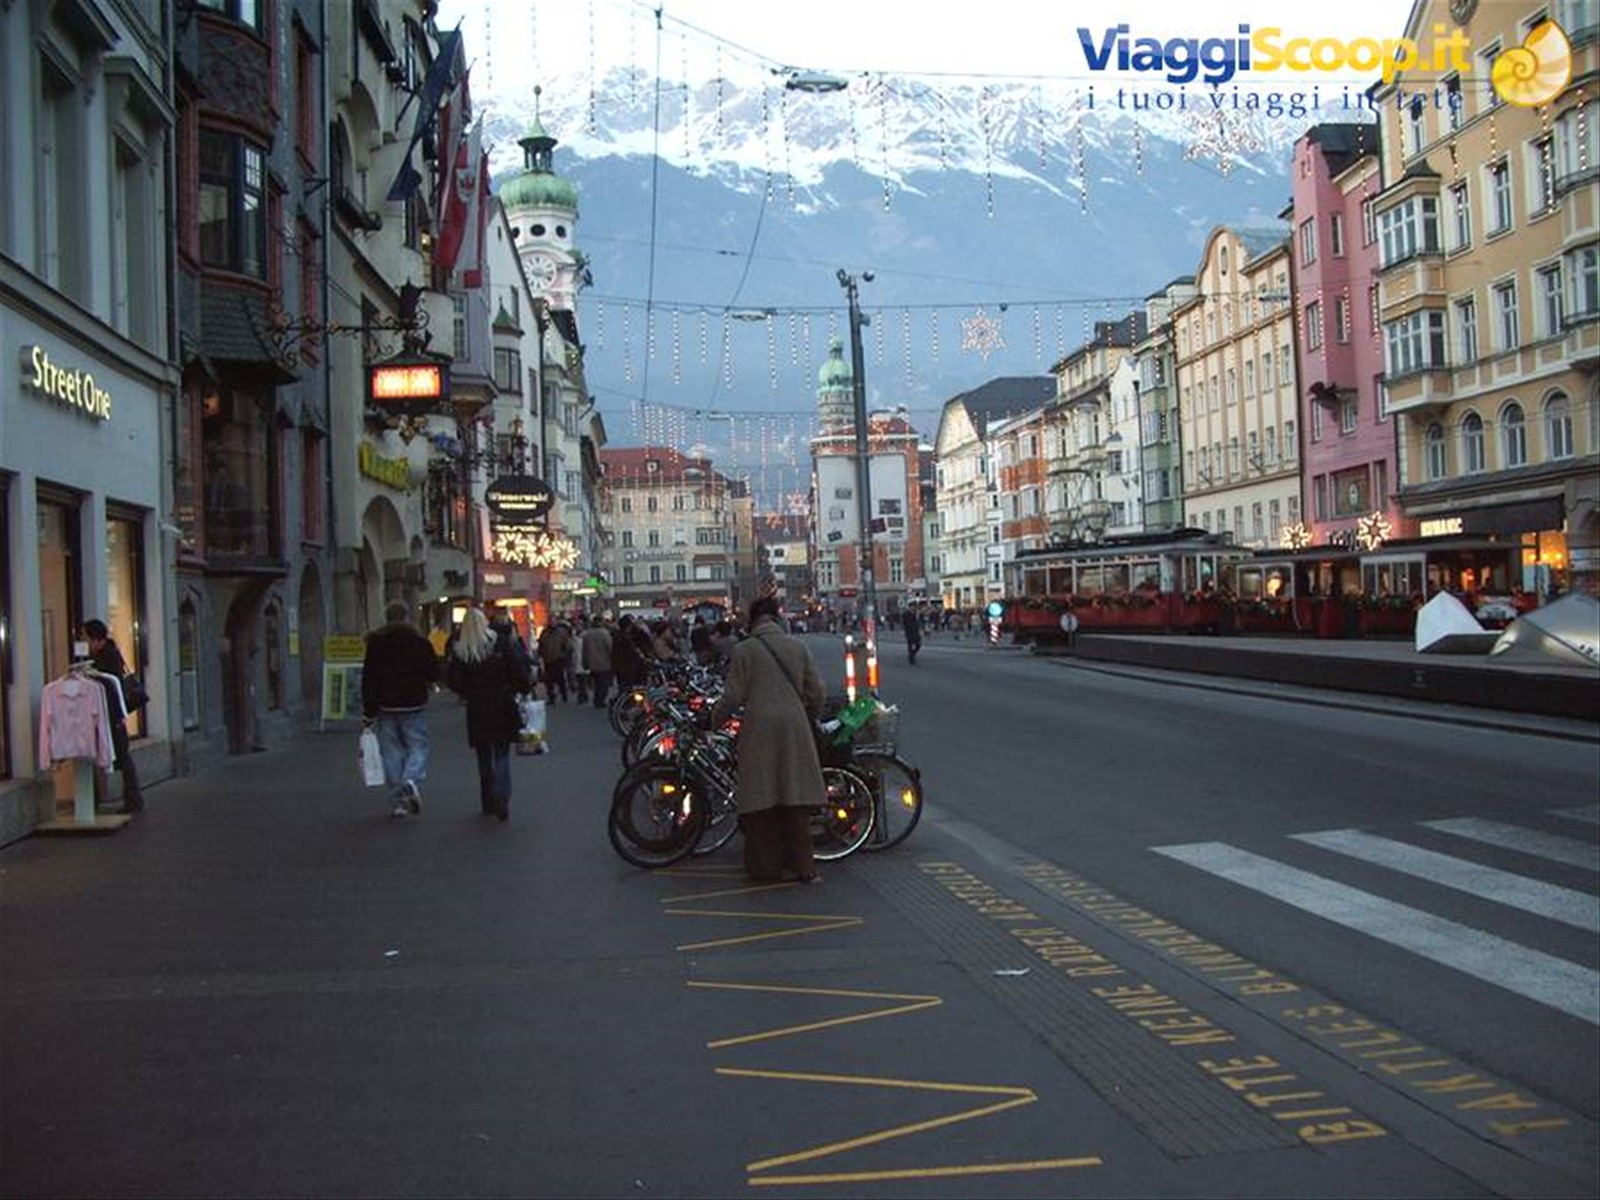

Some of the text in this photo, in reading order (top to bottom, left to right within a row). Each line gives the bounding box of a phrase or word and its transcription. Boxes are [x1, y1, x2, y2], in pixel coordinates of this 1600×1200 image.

[32, 345, 112, 421] Street One
[1090, 983, 1237, 1047] KEINE
[1199, 1053, 1388, 1144] BITTE
